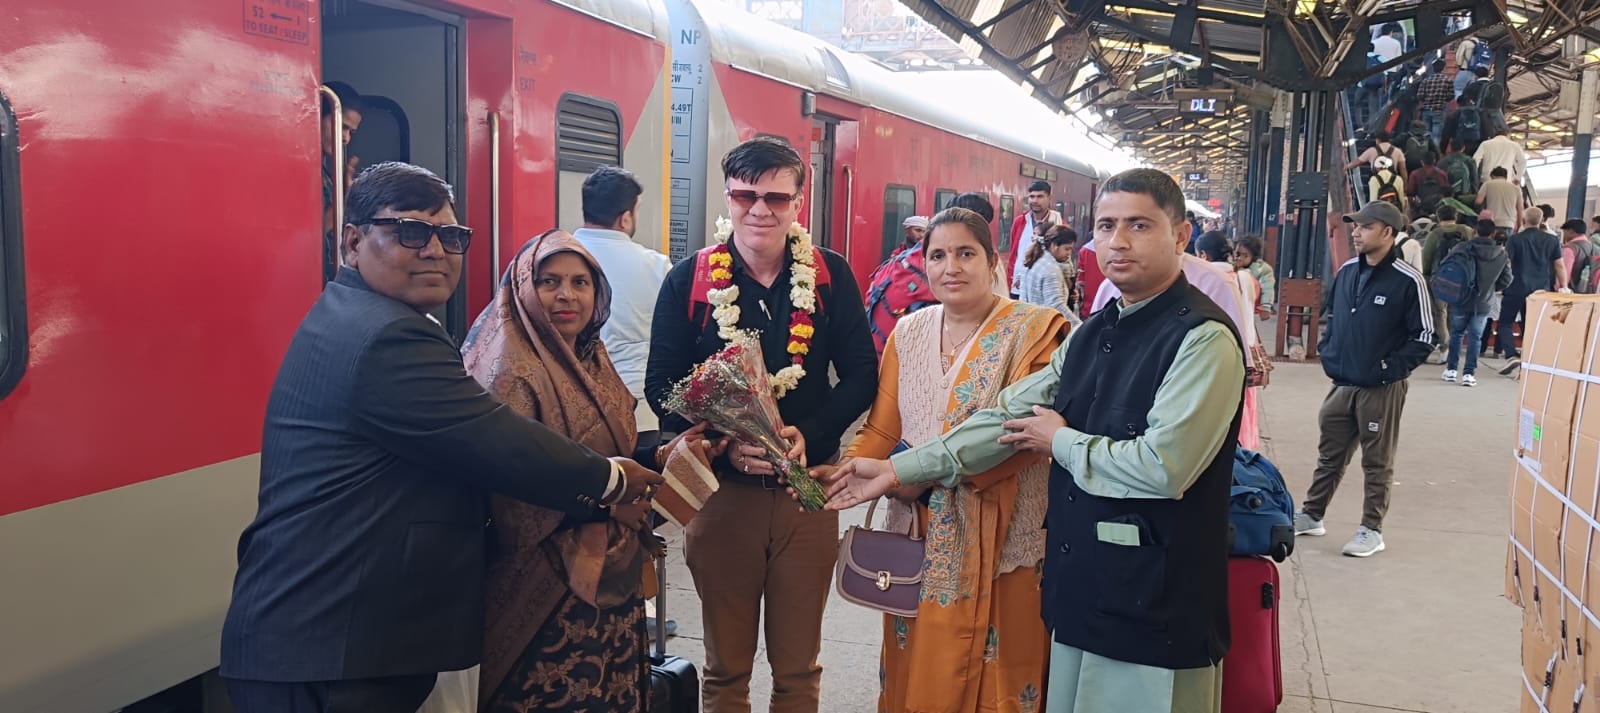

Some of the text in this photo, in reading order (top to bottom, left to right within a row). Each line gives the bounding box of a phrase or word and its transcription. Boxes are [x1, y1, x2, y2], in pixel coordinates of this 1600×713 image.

[244, 20, 256, 31] TO
[258, 23, 278, 35] SEAT
[681, 29, 702, 45] NP
[519, 76, 536, 90] EXIT
[1190, 98, 1216, 112] DLI
